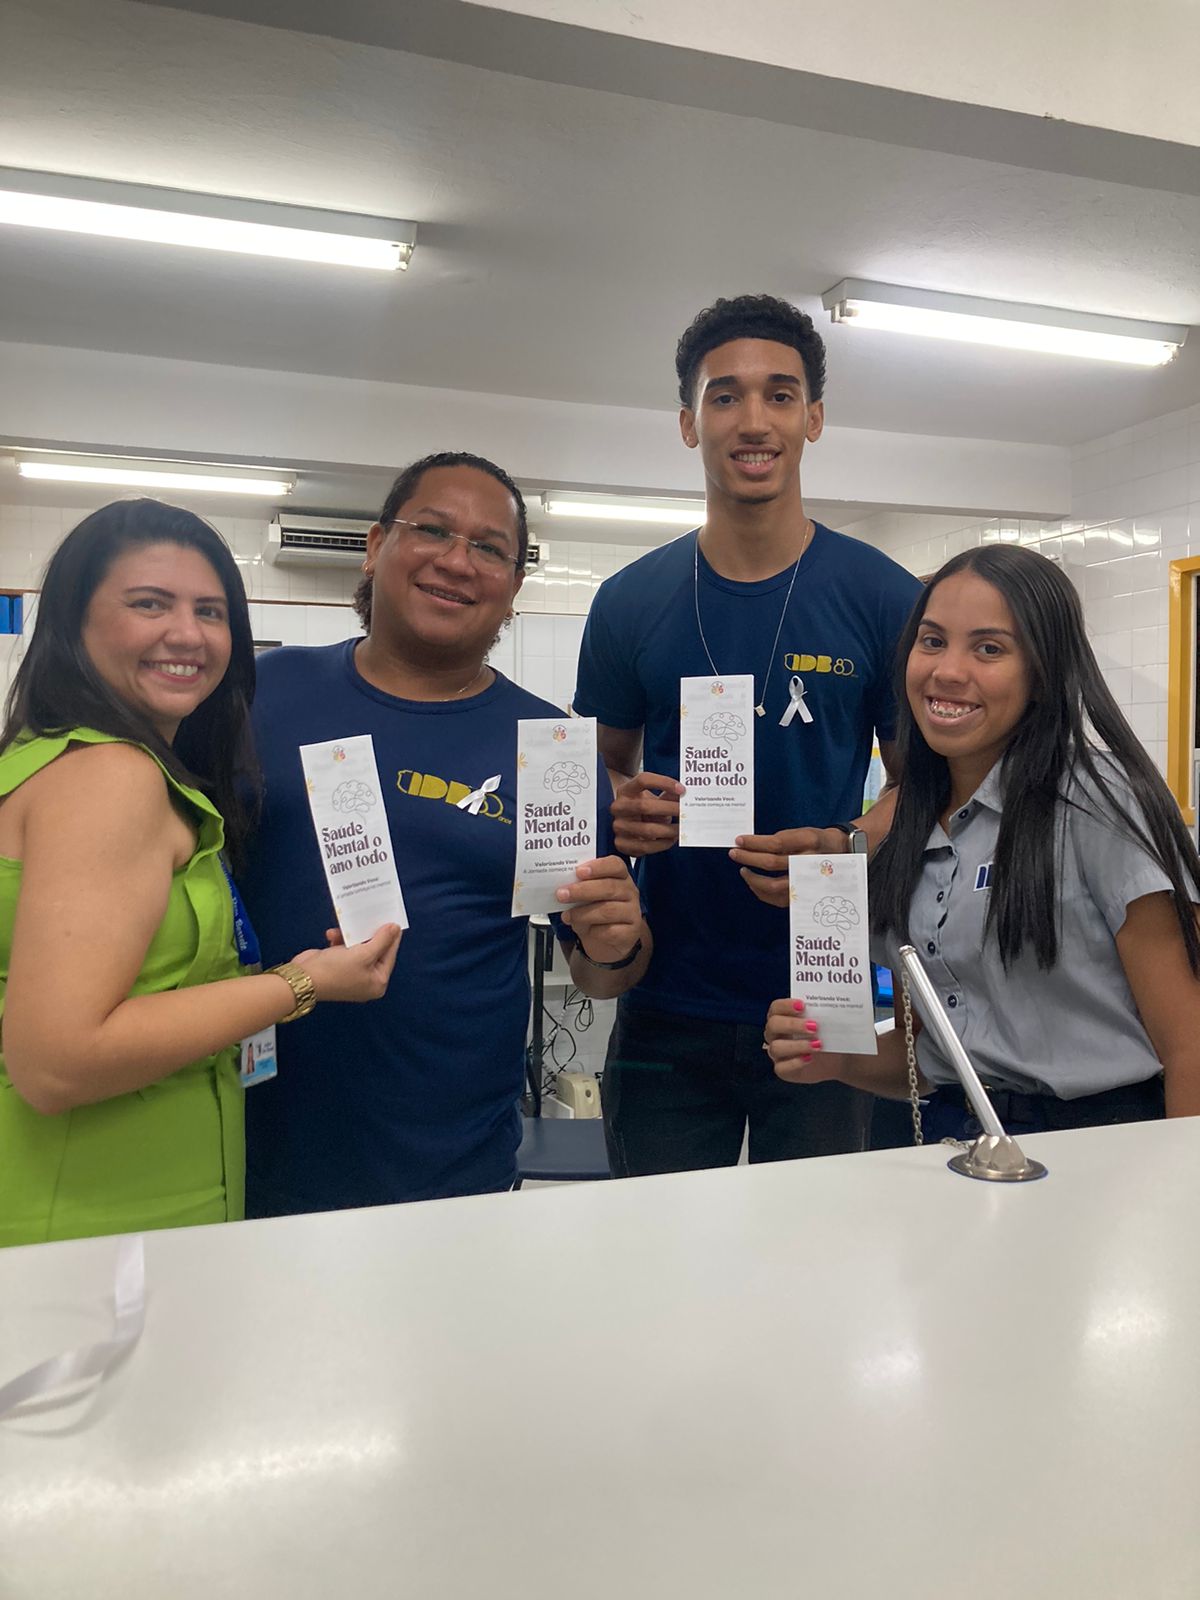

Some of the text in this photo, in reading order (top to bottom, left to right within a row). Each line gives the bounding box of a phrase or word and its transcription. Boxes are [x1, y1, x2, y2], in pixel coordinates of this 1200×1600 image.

[685, 745, 729, 759] Saúde
[685, 760, 745, 773] Mental o
[685, 773, 748, 786] ano todo
[524, 801, 572, 818] Saúde
[321, 821, 364, 843] Saúde
[524, 817, 588, 834] Mental o
[325, 835, 383, 860] Mental o
[524, 831, 591, 850] ano todo
[329, 848, 389, 876] ano todo
[795, 935, 841, 951] Saúde
[795, 951, 859, 968] Mental o
[795, 969, 863, 985] ano todo
